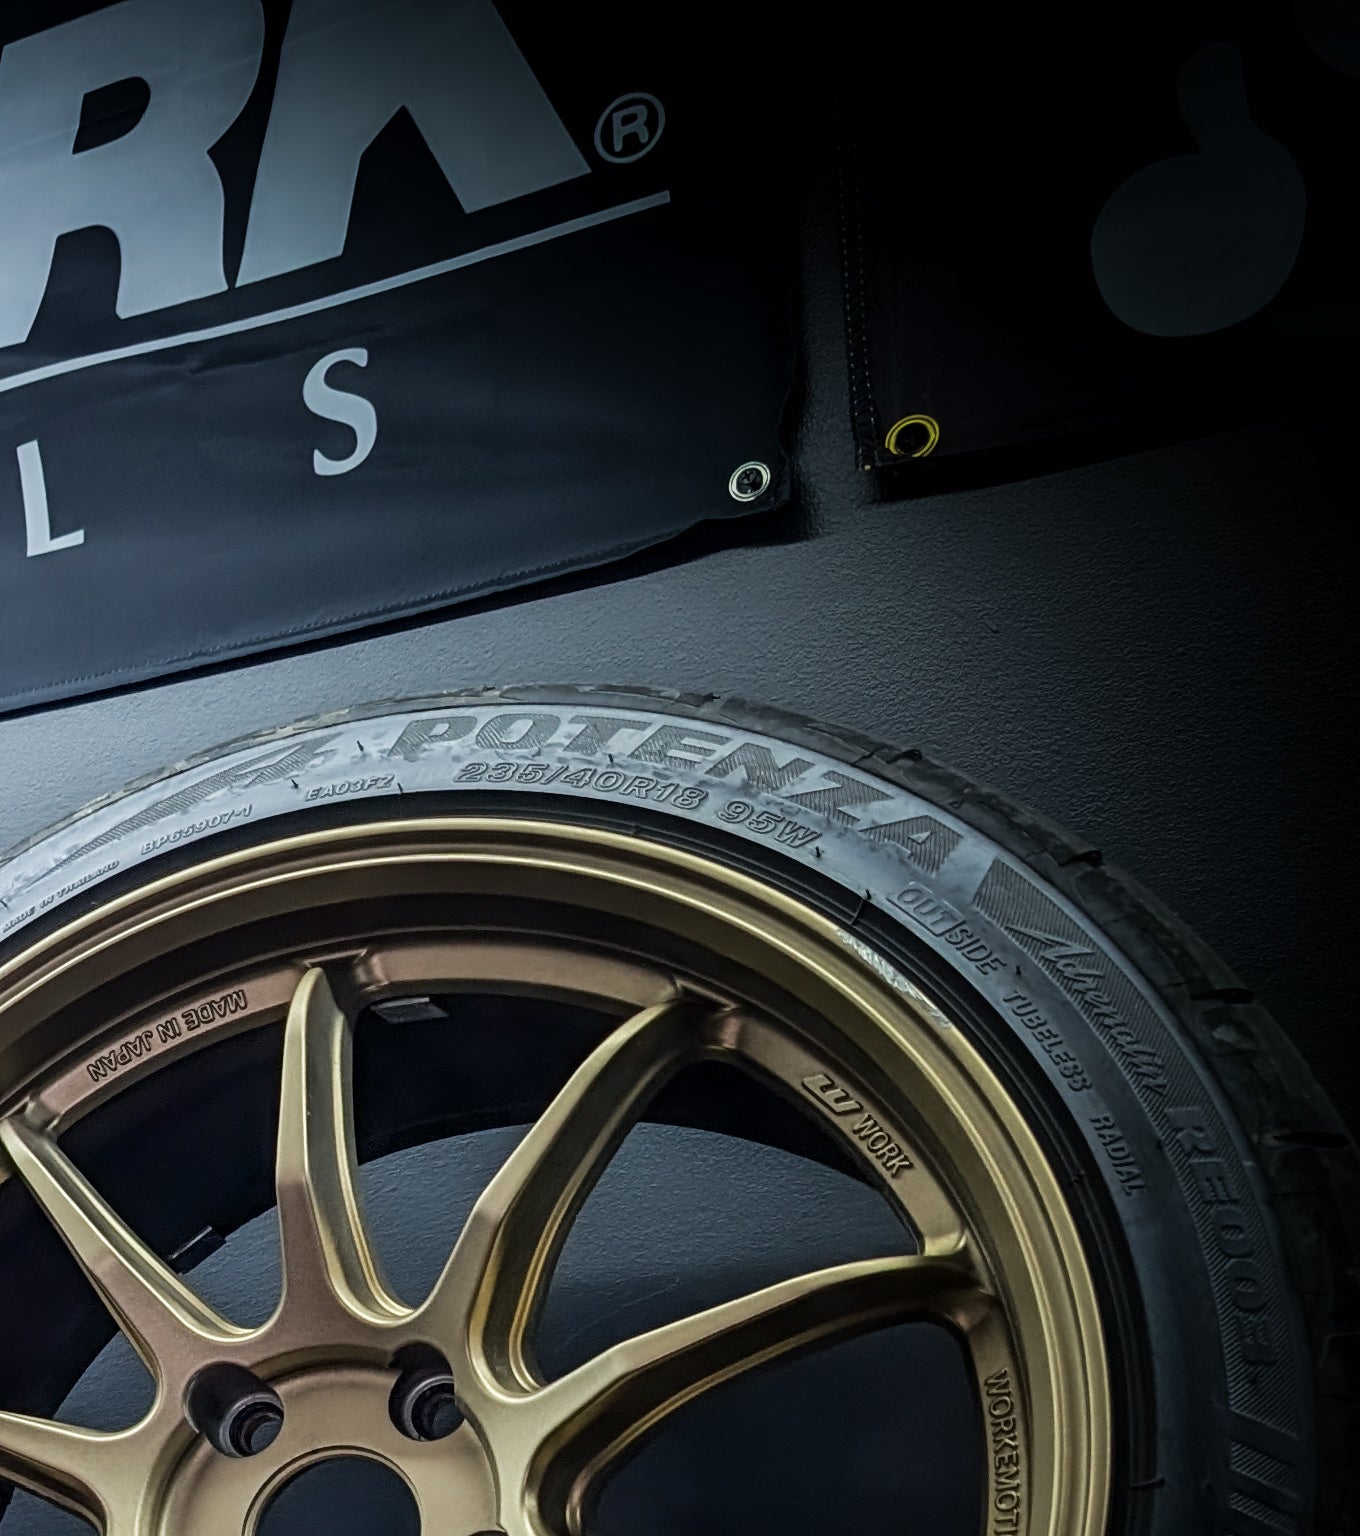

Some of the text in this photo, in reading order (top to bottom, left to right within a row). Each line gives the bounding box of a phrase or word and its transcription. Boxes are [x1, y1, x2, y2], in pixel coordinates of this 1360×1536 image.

[388, 712, 962, 878] POTENZA
[454, 761, 826, 849] 235/40R18 95W
[85, 990, 248, 1083] MADE IN JAPAN
[1000, 990, 1147, 1196] TUBELESS RADIAL
[854, 1113, 912, 1180] WORK
